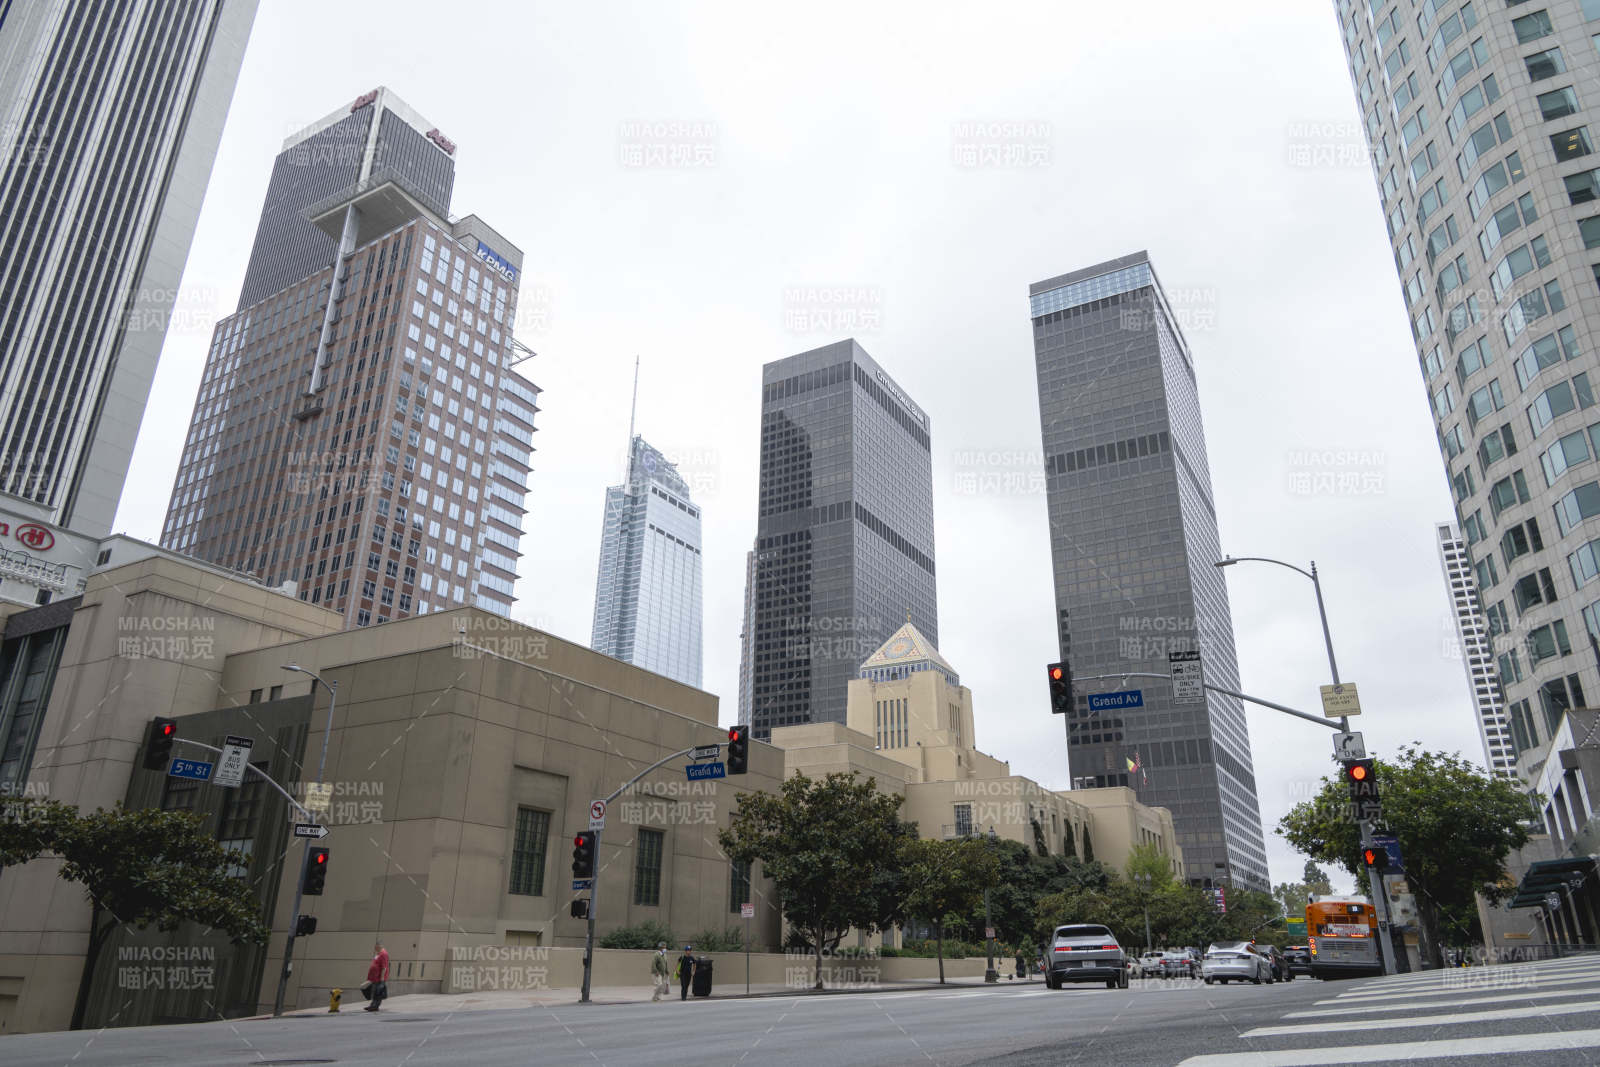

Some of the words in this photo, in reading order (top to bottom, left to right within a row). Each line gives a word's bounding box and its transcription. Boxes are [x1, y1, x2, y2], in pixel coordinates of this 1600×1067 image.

[477, 249, 514, 281] KPMG
[1092, 695, 1123, 707] Grand
[1126, 694, 1139, 704] Av
[175, 762, 193, 774] 5th
[195, 766, 208, 776] St
[690, 767, 711, 777] Grand
